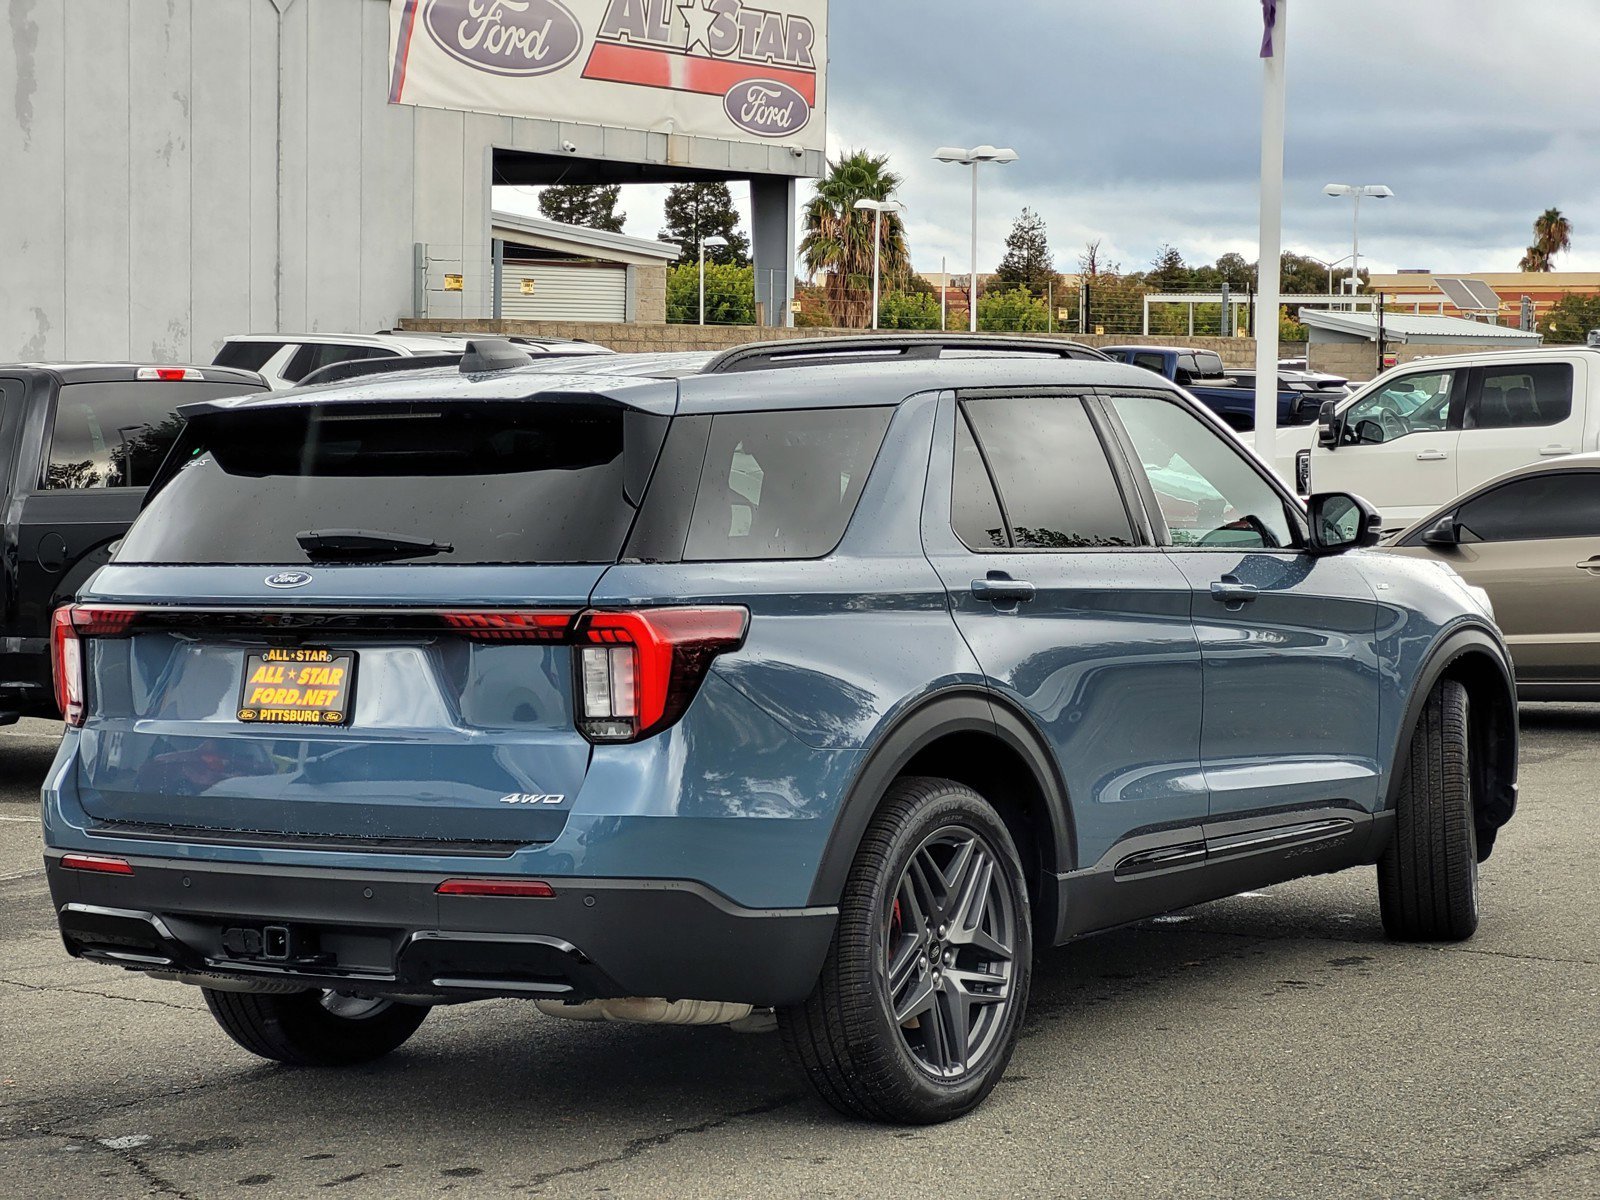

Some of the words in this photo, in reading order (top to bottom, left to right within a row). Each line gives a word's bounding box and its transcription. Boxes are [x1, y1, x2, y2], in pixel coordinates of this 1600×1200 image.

[457, 0, 553, 61] Ford
[709, 0, 816, 68] STAR
[740, 85, 793, 128] Ford
[268, 649, 290, 661] ALL
[296, 650, 328, 662] STAR
[250, 666, 285, 684] ALL
[297, 667, 344, 686] STAR
[249, 687, 339, 706] FORD.NET
[260, 709, 319, 722] PITTSBURG
[499, 793, 565, 804] 4WD
